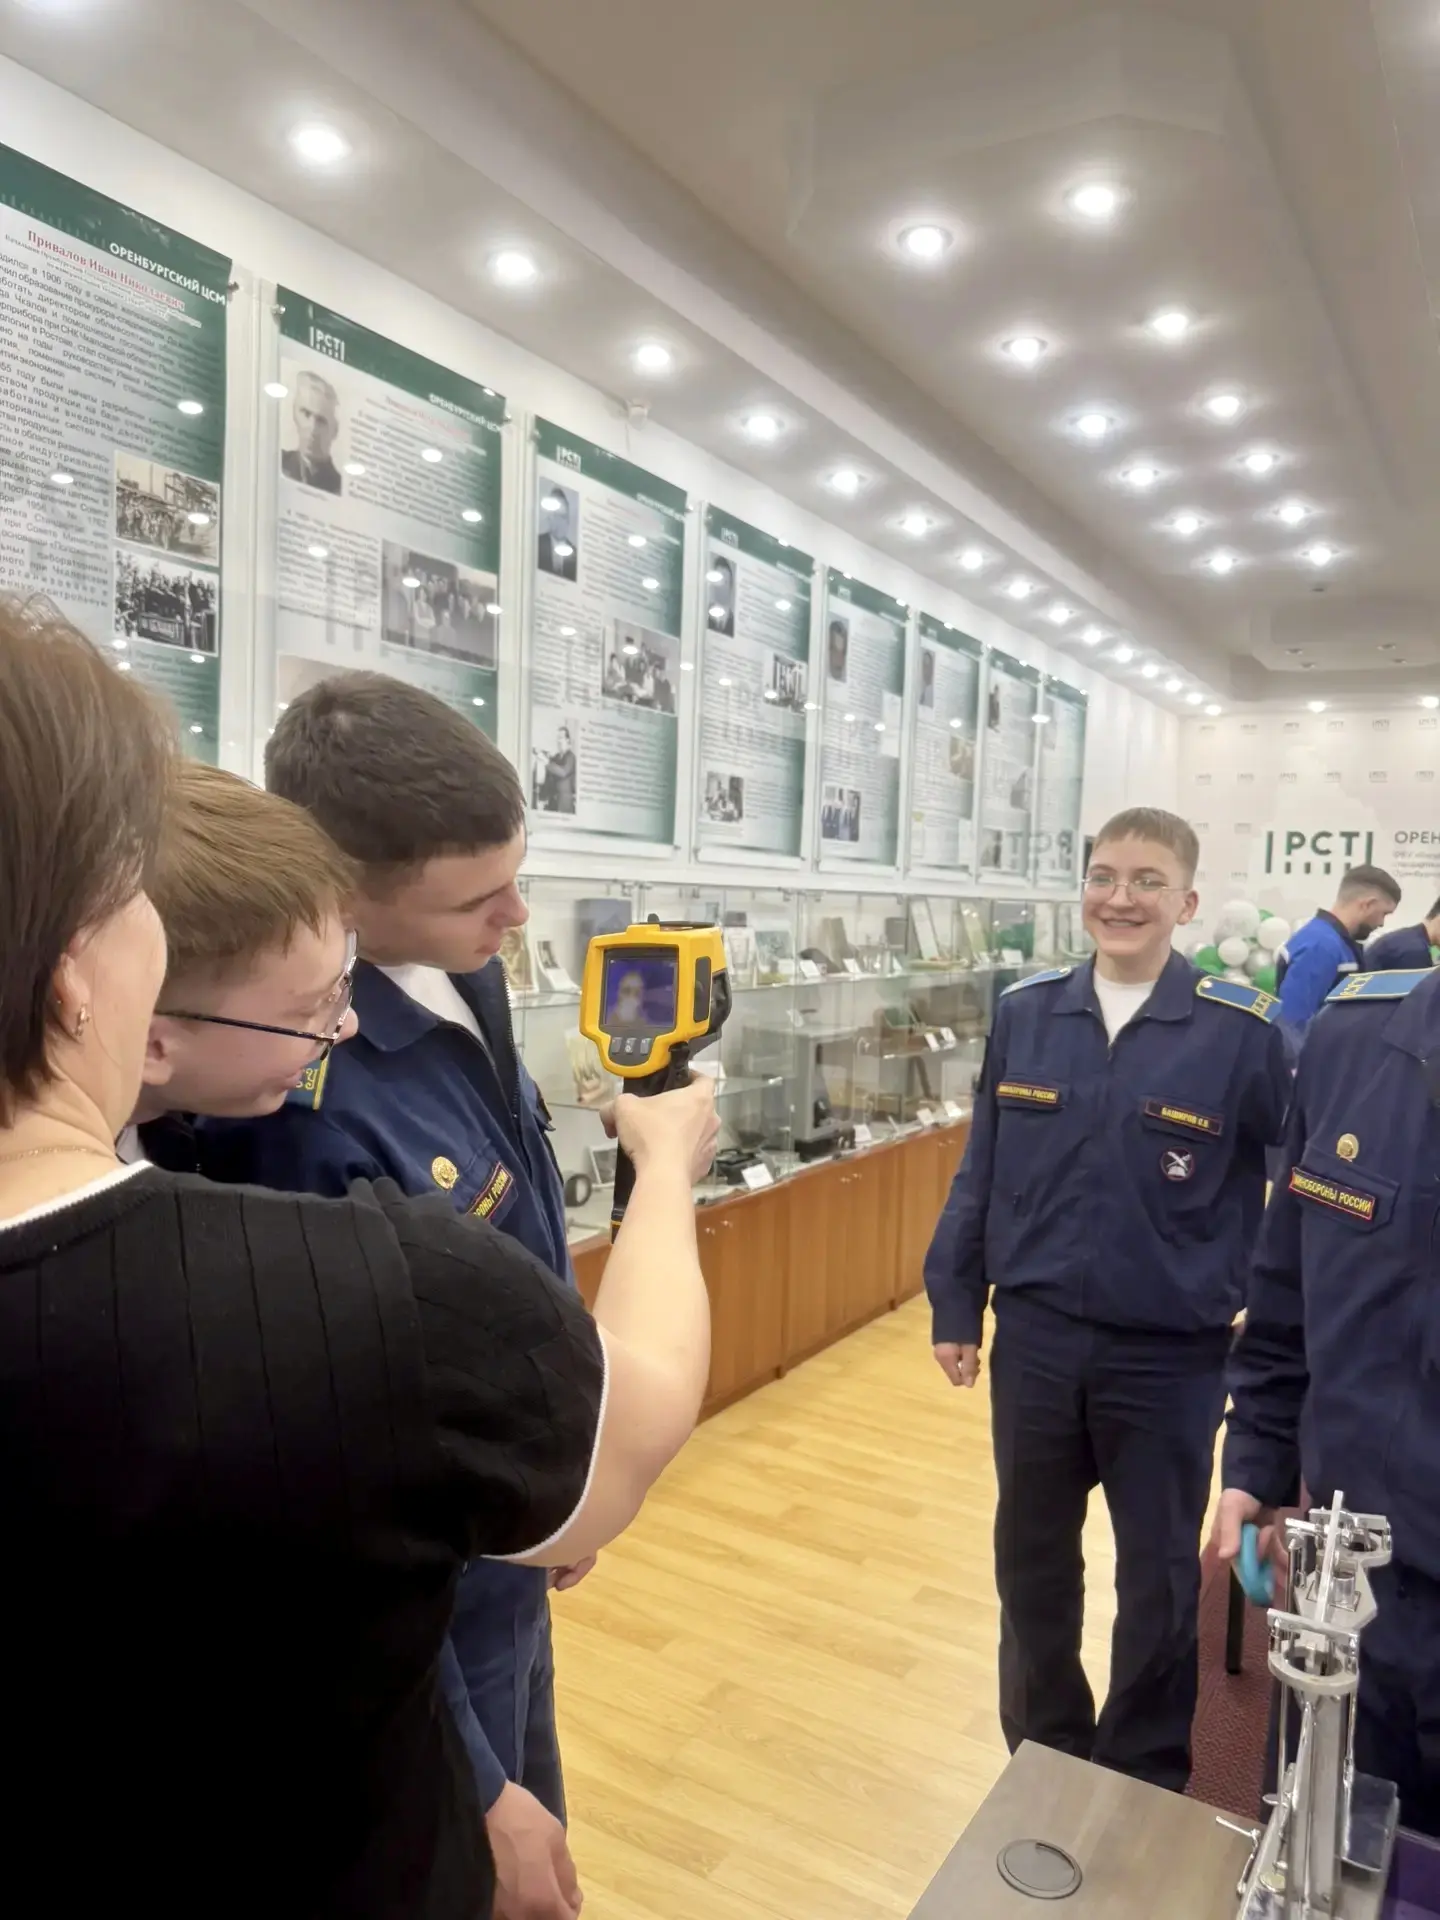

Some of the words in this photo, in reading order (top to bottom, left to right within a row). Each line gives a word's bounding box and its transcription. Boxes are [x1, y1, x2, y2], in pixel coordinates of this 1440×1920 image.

[0, 264, 17, 278] чил
[109, 242, 200, 294] ОРЕНБУРГСКИЙ
[201, 285, 226, 306] ЦСМ
[0, 274, 32, 297] ботать
[0, 298, 42, 325] рприбора
[0, 384, 47, 410] аботаны
[1285, 831, 1360, 856] РСТ
[1394, 831, 1440, 844] ОРЕН
[474, 1193, 495, 1216] РОНЫ
[1338, 1192, 1373, 1213] РОССИИ
